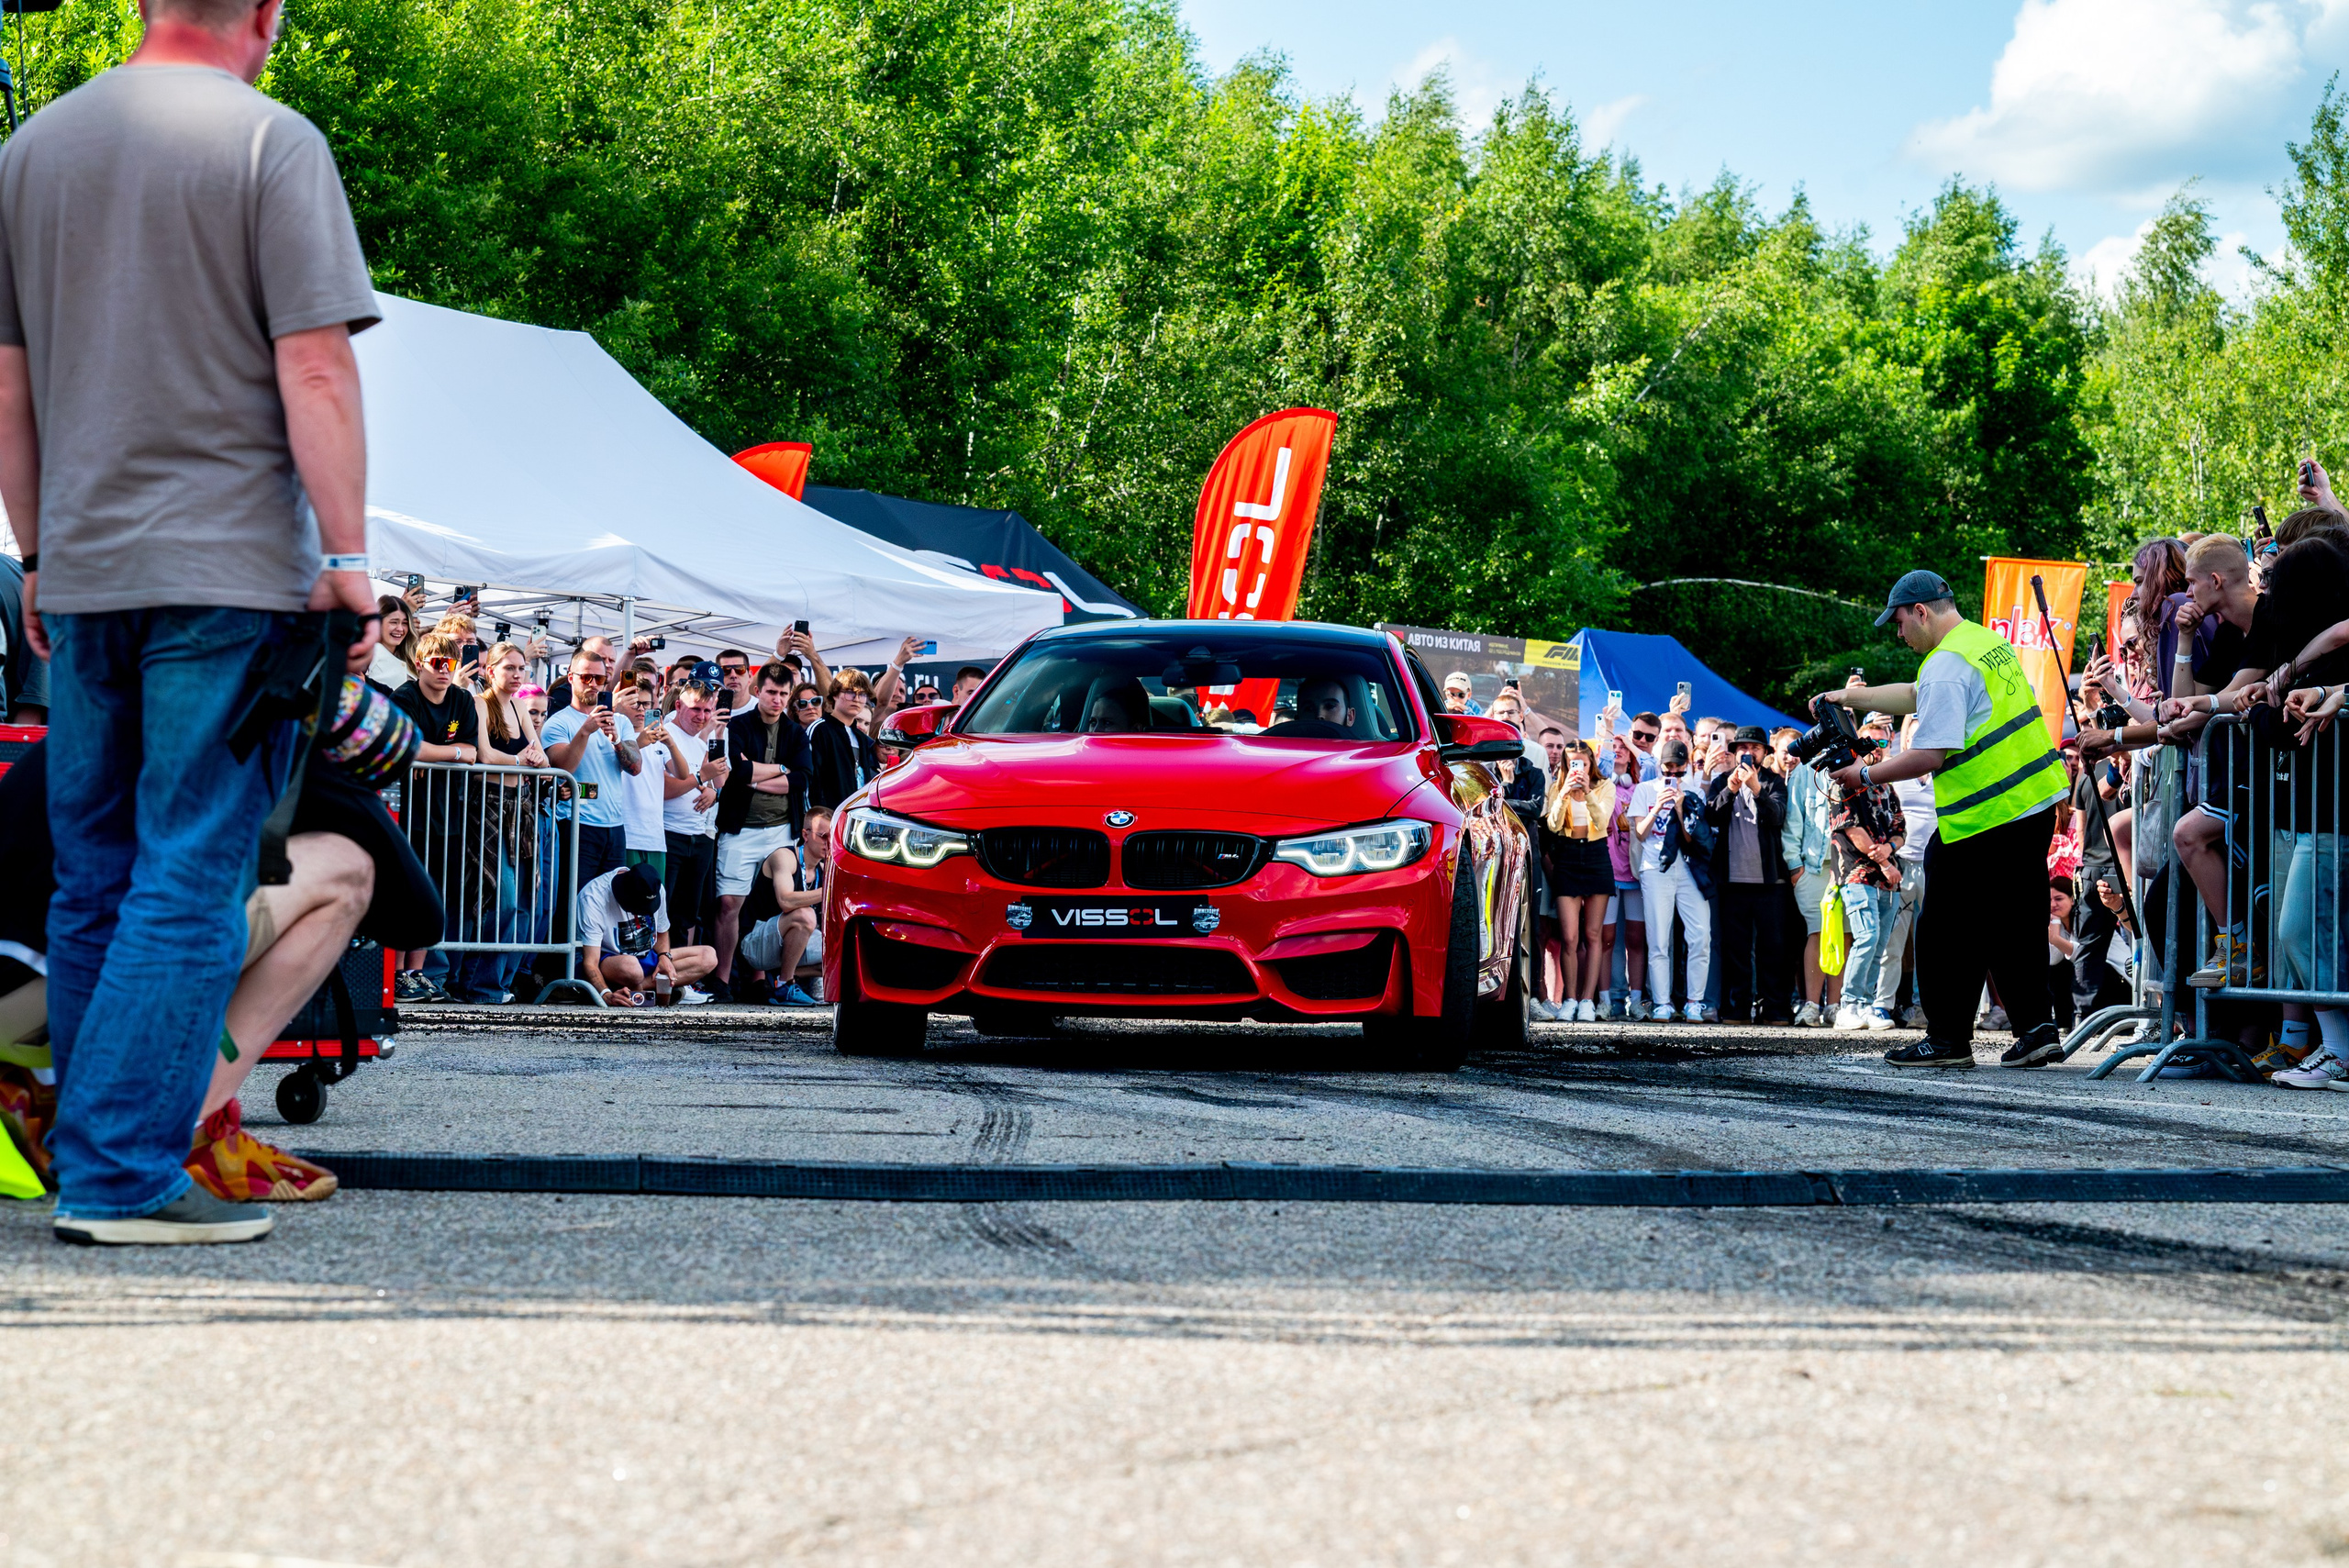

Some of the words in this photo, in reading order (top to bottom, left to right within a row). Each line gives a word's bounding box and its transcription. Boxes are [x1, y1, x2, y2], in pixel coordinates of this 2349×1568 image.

[1408, 633, 1433, 648] АВТО
[1434, 636, 1449, 650] ИЗ
[1449, 637, 1481, 652] КИТАЯ
[1052, 908, 1177, 926] VISSOL
